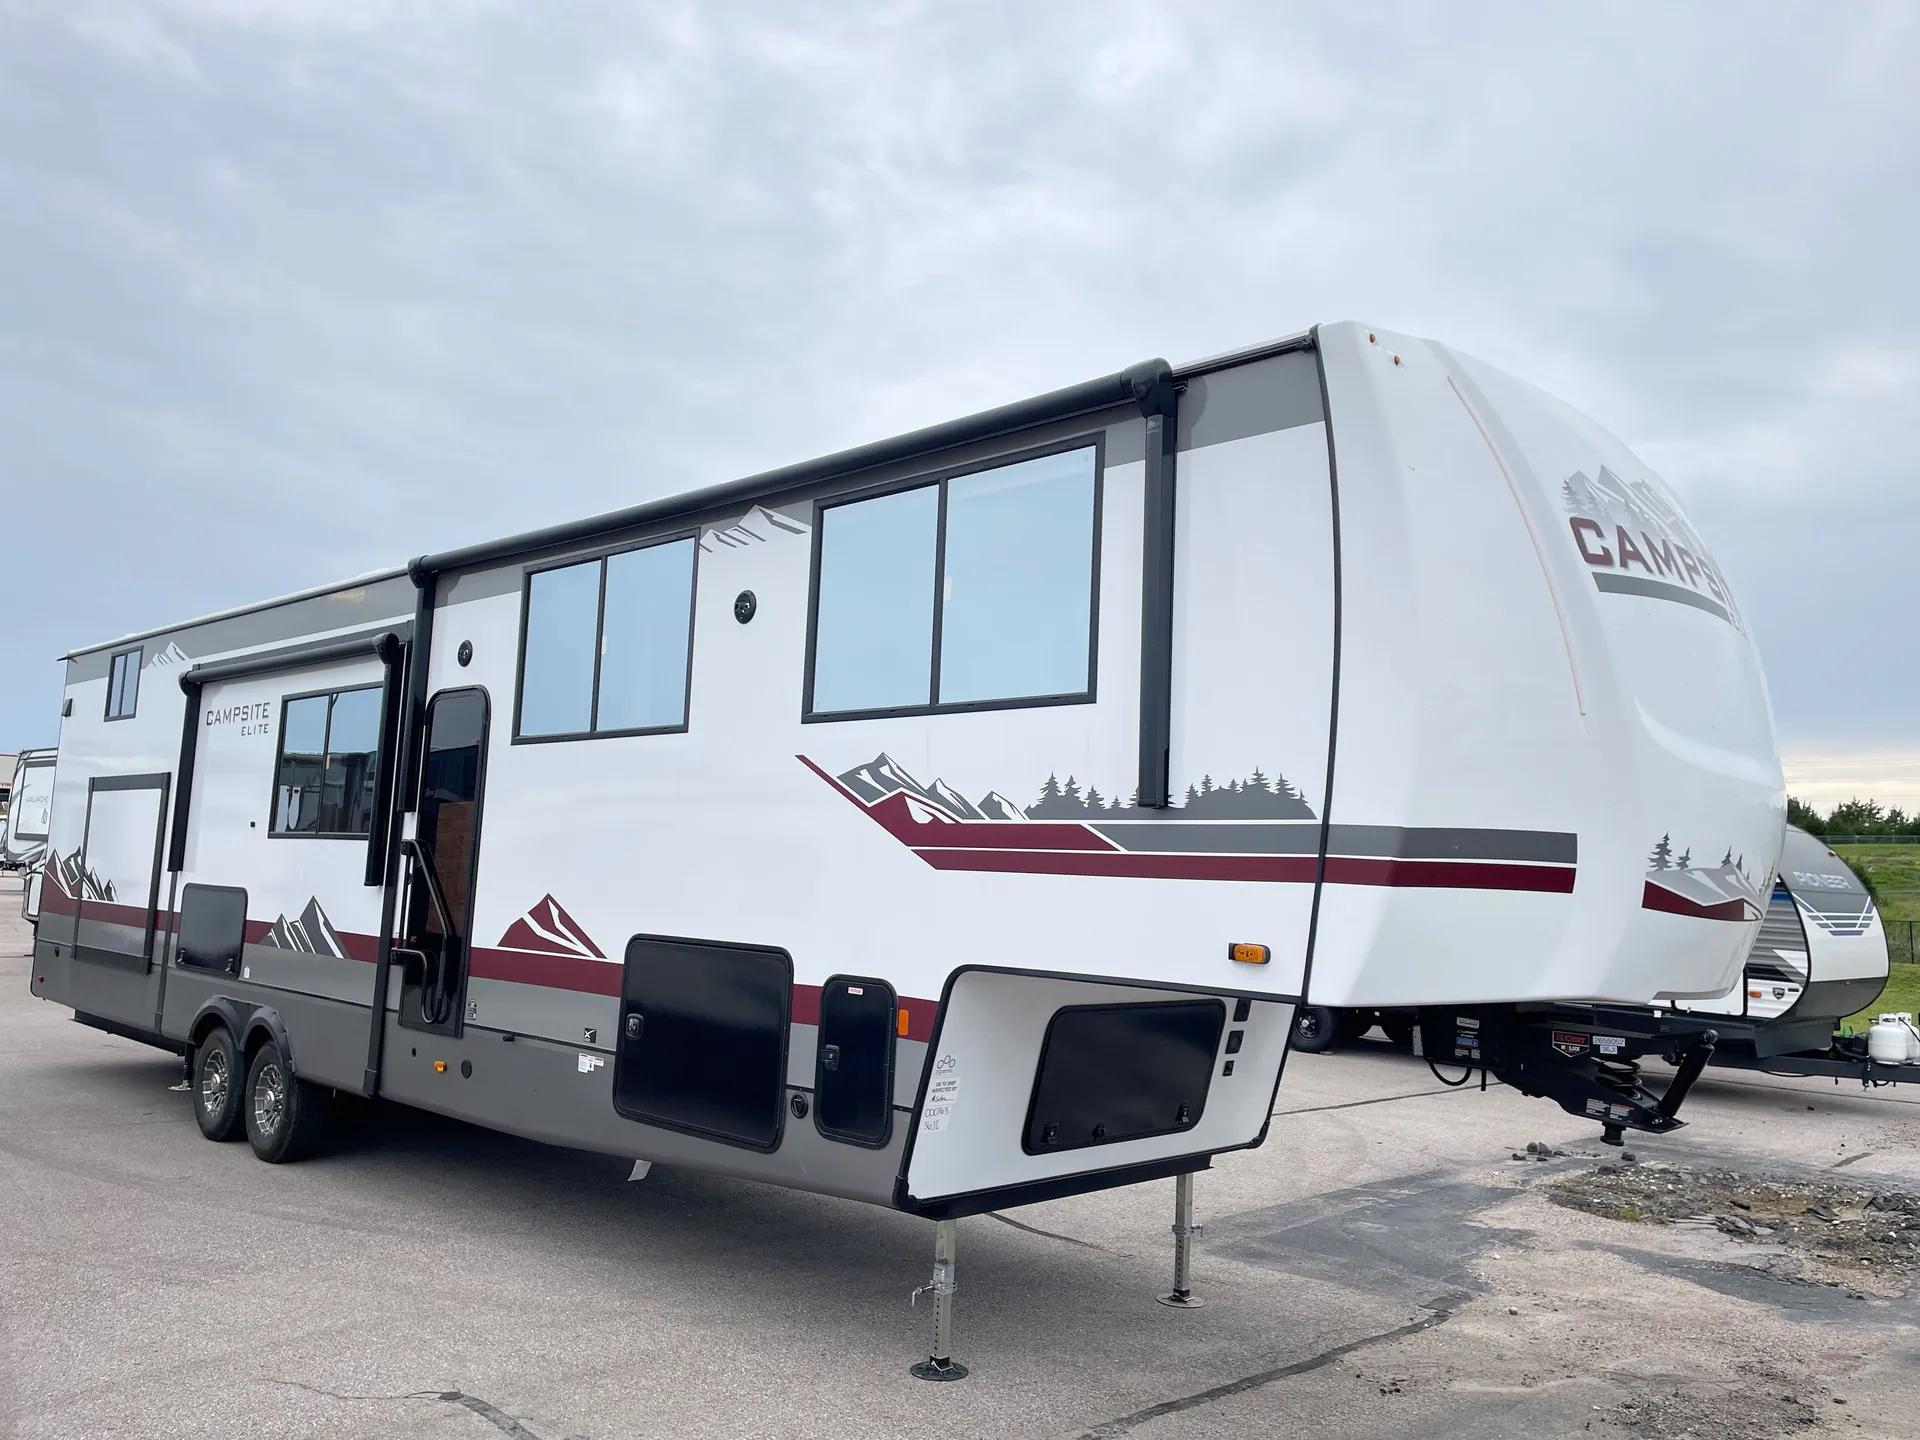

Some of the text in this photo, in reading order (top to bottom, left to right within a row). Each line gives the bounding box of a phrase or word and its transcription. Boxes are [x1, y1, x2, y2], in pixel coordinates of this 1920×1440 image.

[206, 702, 271, 726] CAMPSITE
[241, 723, 269, 737] ELITE
[1792, 871, 1853, 890] PIONEER
